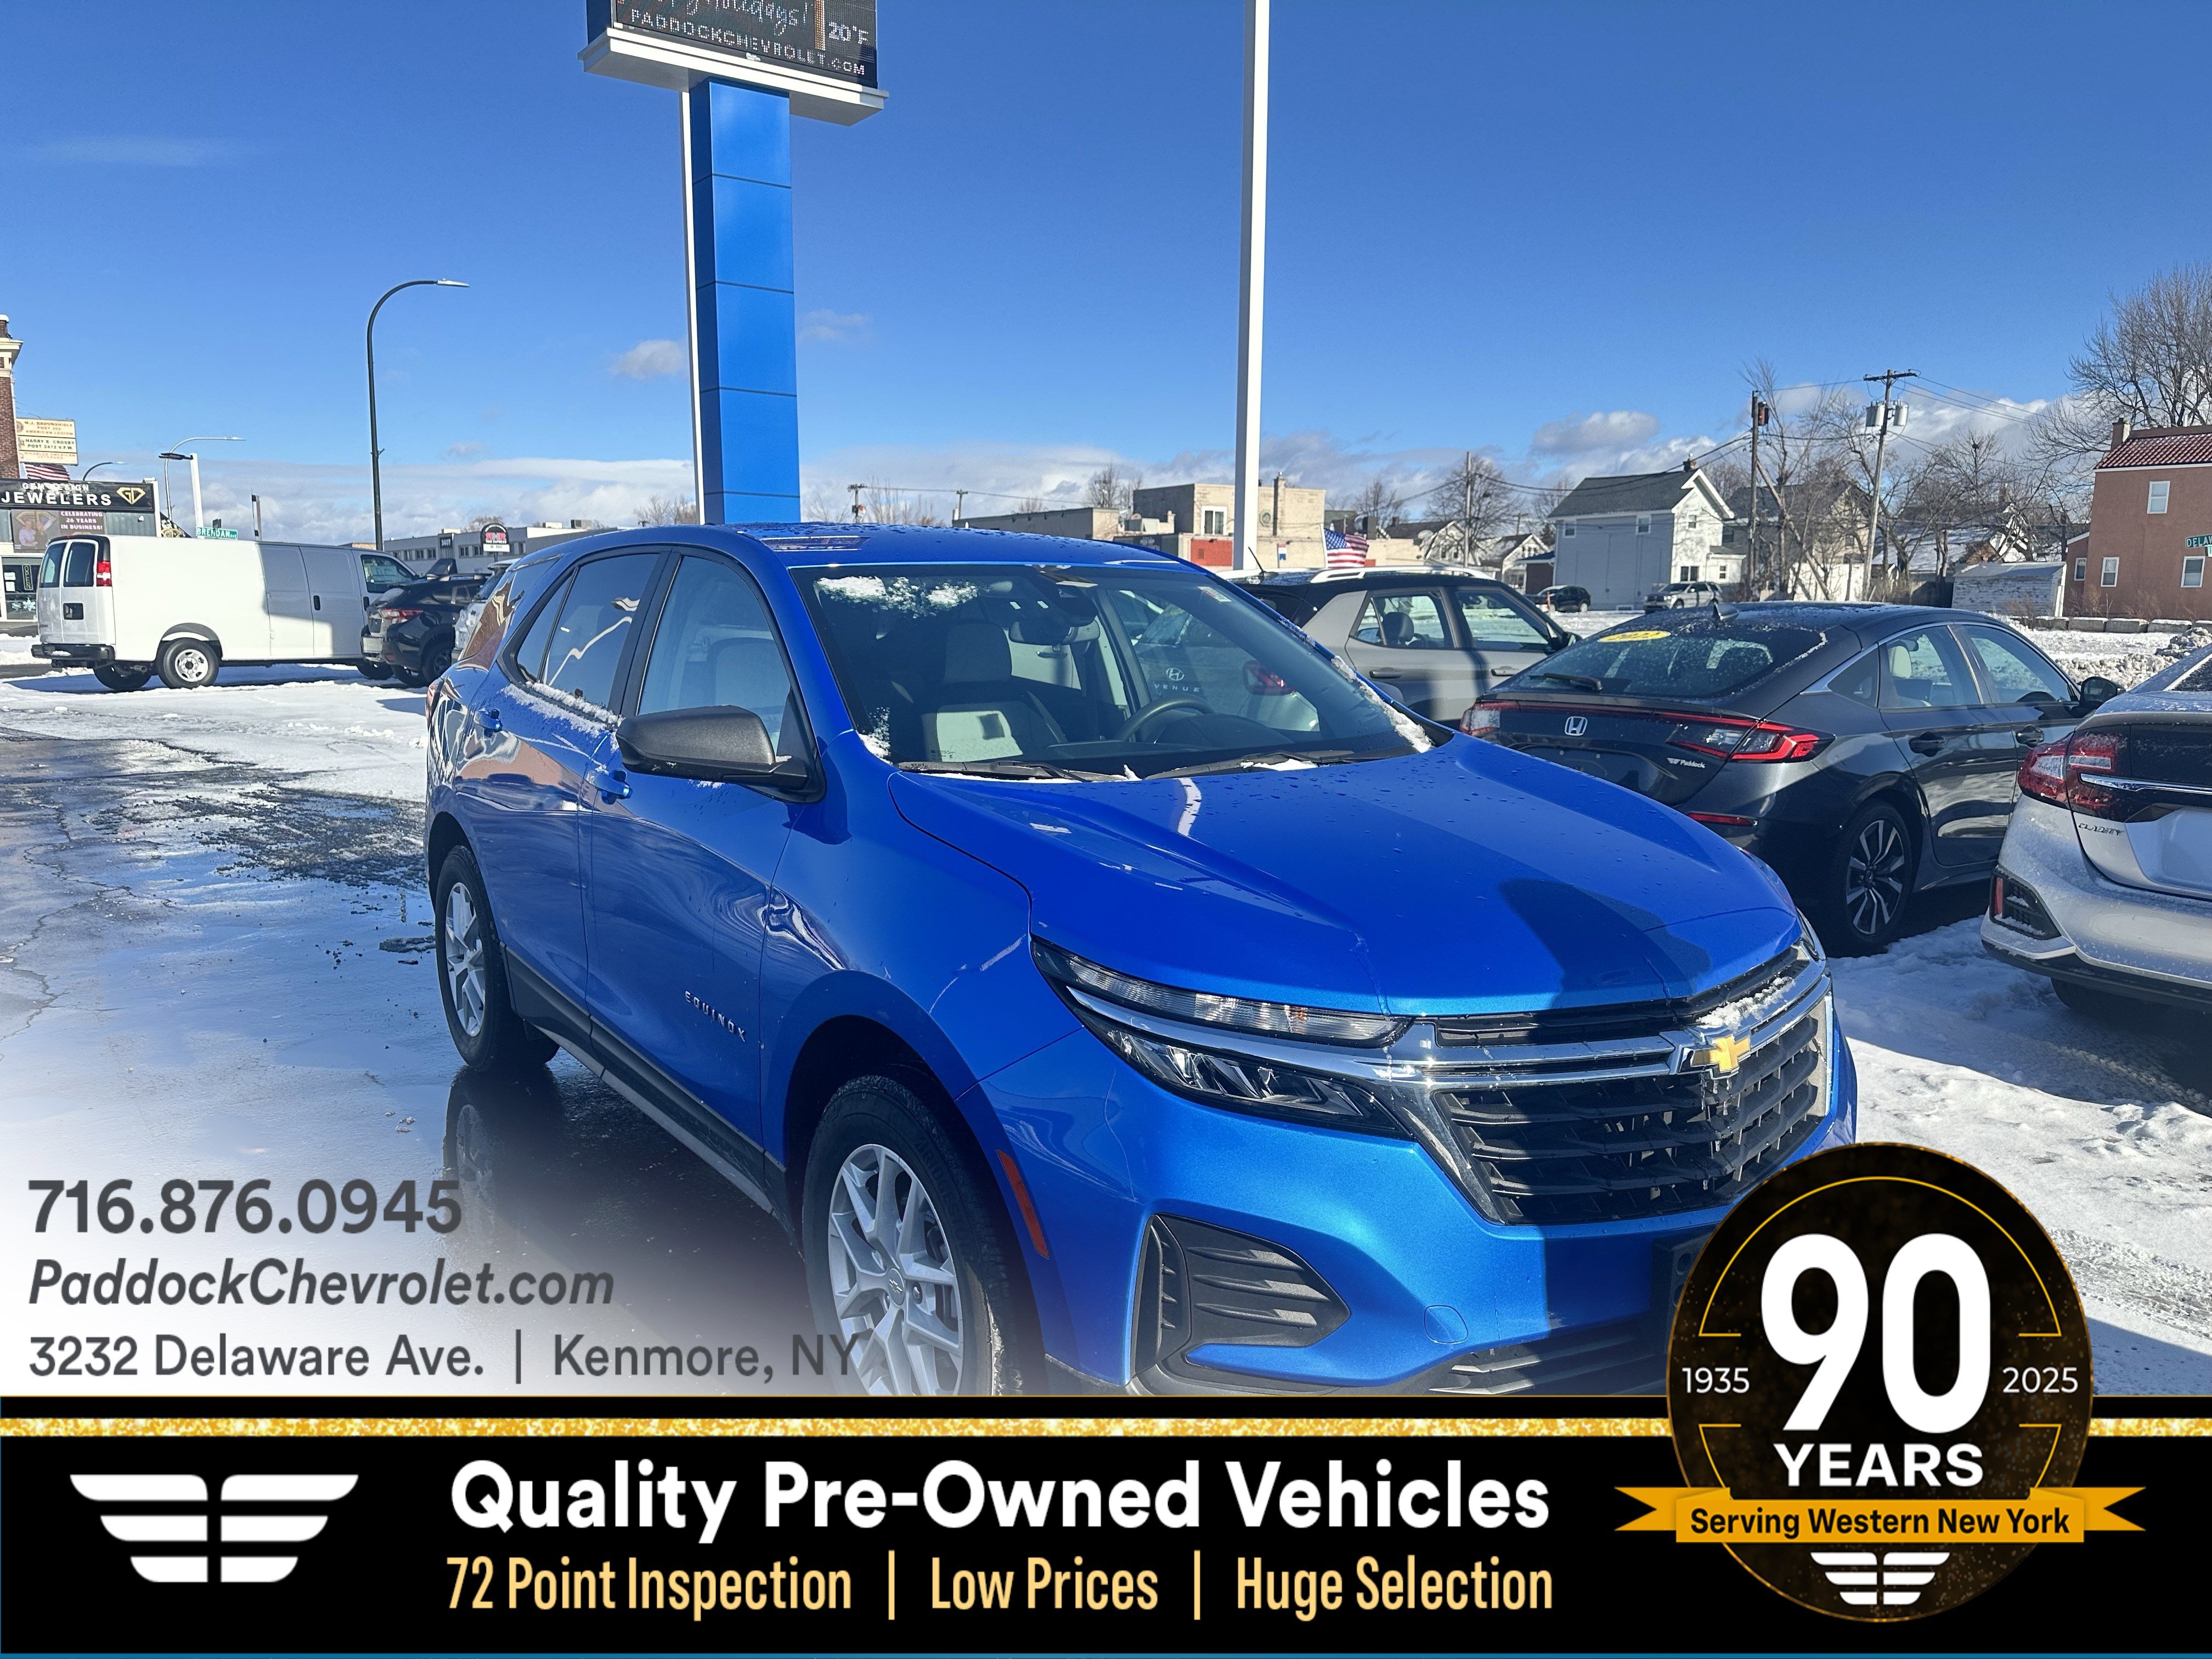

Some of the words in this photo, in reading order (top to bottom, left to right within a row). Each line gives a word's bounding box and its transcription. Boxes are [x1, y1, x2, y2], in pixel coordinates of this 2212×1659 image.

[631, 8, 865, 75] PADDOCKCHEVROLET.COM
[1, 491, 111, 506] JEWELERS
[196, 527, 230, 538] BRENDAN
[1154, 684, 1200, 692] VENUE
[1680, 759, 1706, 769] Paddock
[2078, 823, 2125, 836] CLARITY
[685, 990, 746, 1043] EQUINOX
